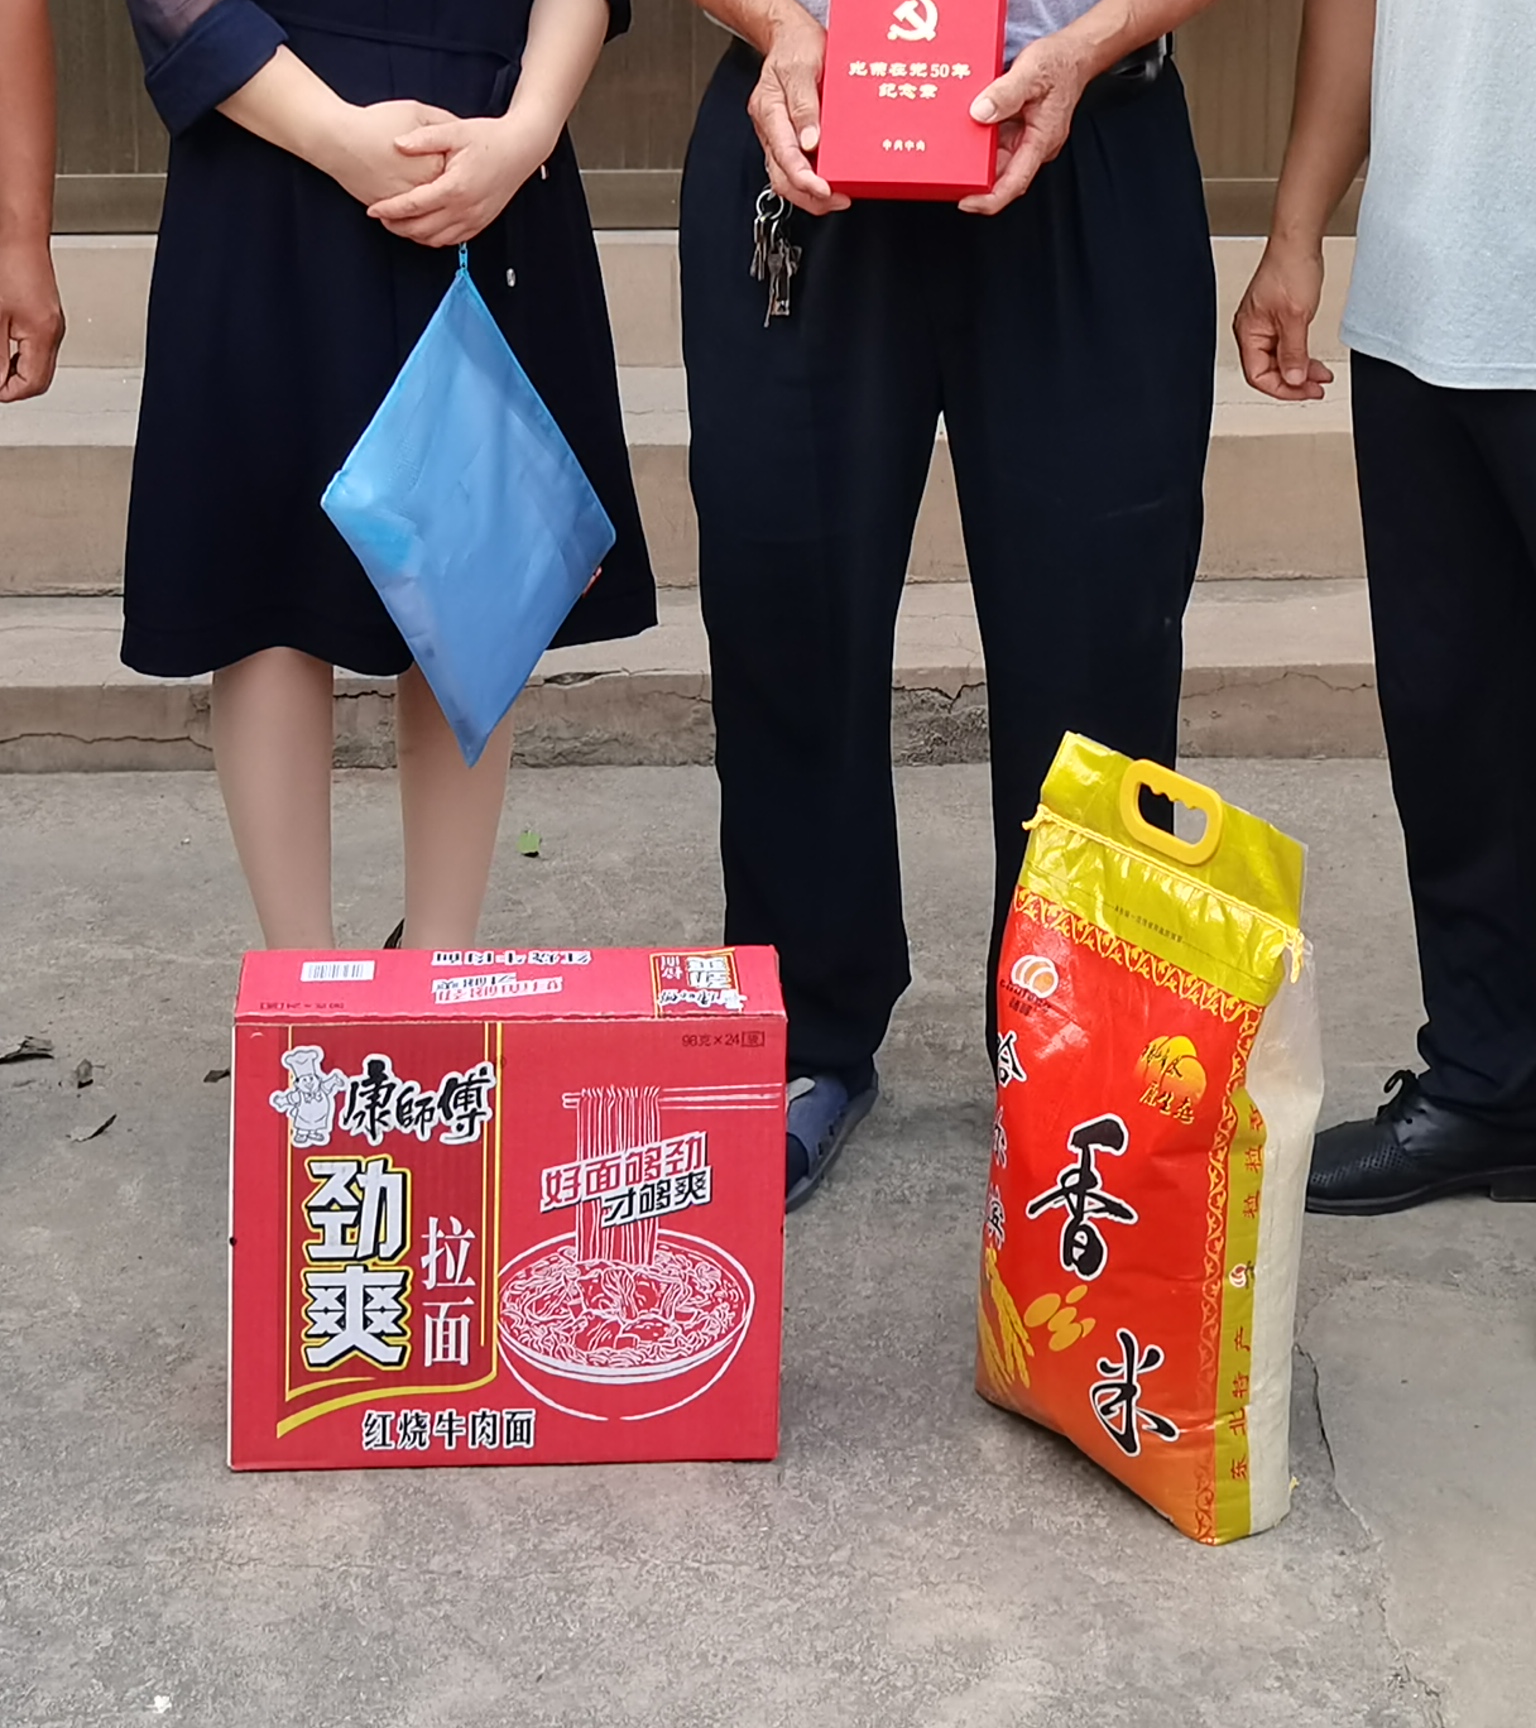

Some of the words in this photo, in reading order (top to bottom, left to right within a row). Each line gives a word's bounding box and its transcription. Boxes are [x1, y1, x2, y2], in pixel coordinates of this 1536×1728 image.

[545, 1136, 703, 1207] 好面够劲
[602, 1170, 707, 1223] 才够爽
[305, 1158, 409, 1368] 劲爽
[421, 1216, 476, 1368] 拉面
[364, 1411, 535, 1448] 红烧牛肉面
[1228, 1326, 1250, 1479] 东北特产
